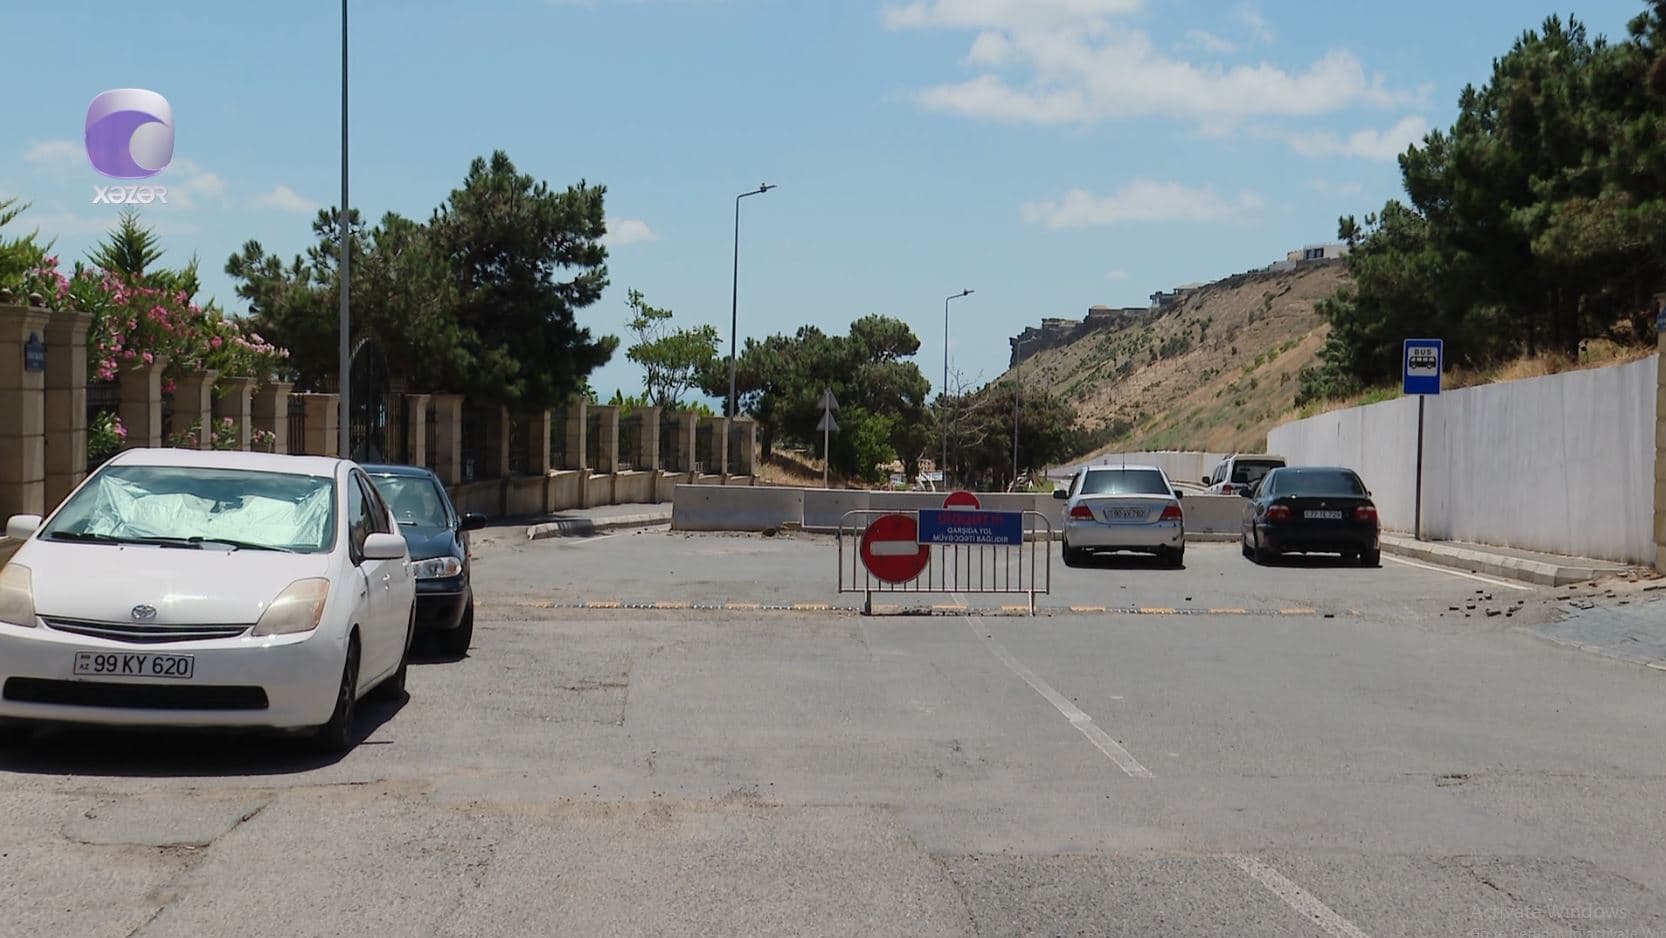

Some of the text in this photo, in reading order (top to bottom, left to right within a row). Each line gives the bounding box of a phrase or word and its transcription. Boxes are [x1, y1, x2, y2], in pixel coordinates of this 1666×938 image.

[980, 527, 993, 535] YOL
[94, 654, 188, 675] 99 KY 620
